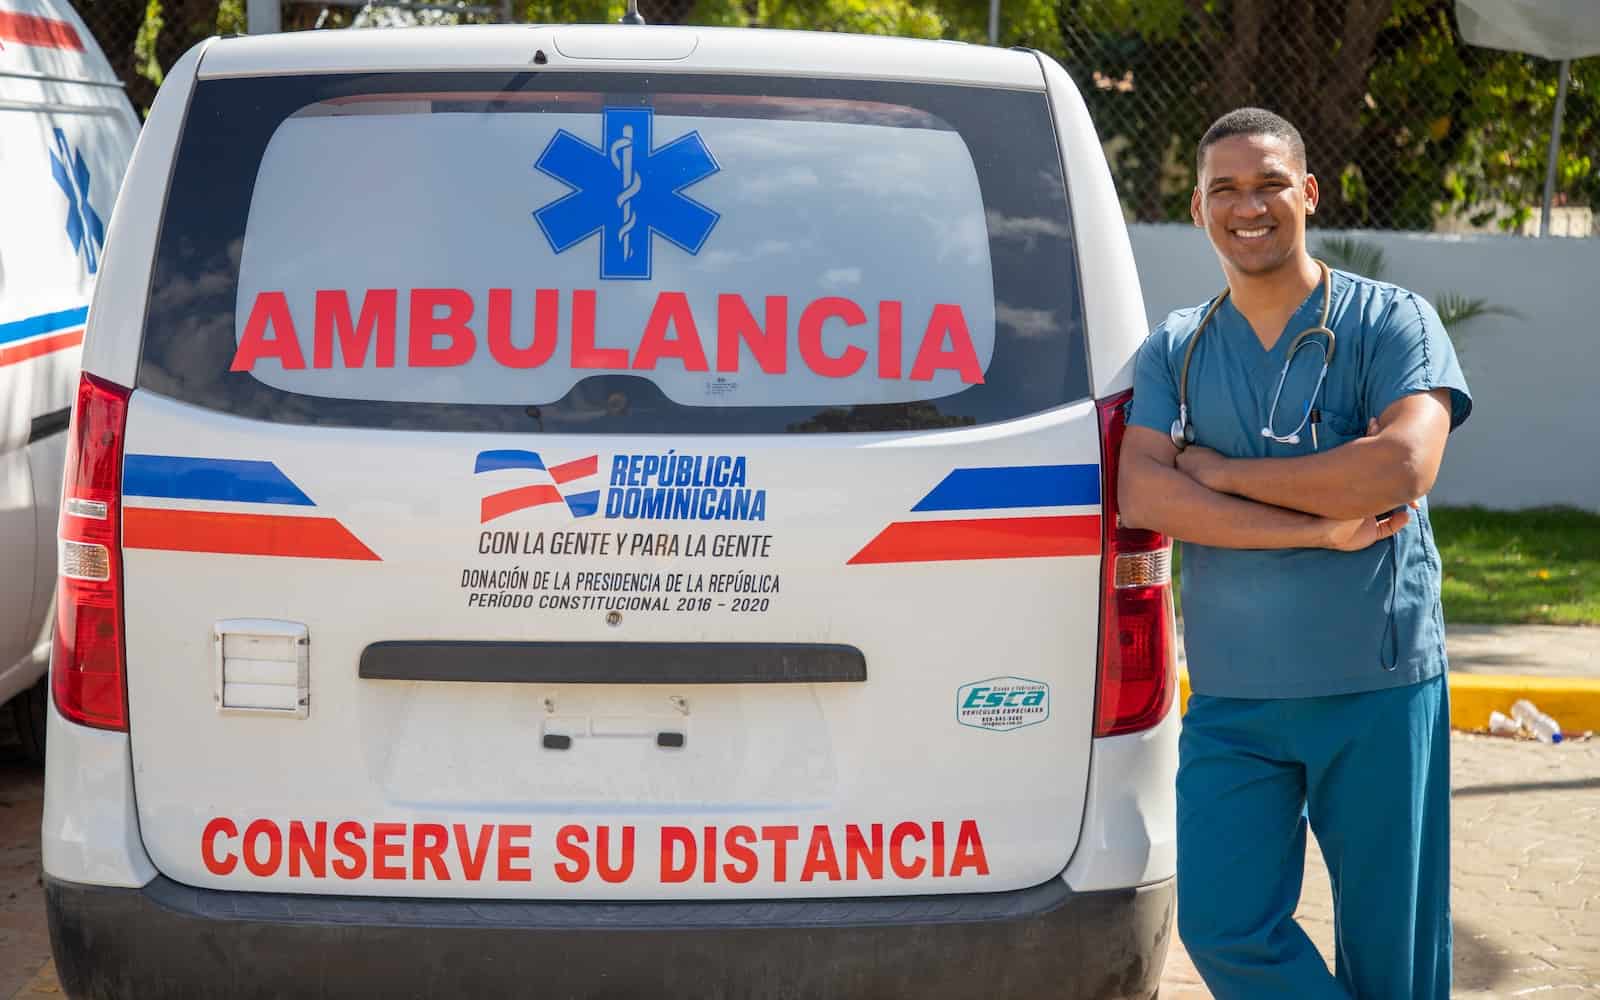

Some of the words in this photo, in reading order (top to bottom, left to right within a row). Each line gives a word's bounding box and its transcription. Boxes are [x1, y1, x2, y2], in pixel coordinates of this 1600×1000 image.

[230, 287, 984, 385] AMBULANCIA
[609, 448, 747, 487] REPÚBLICA
[604, 488, 767, 522] DOMINICANA
[479, 531, 519, 555] CON
[523, 531, 544, 555] LA
[550, 532, 612, 556] GENTE
[616, 532, 628, 556] Y
[630, 533, 679, 557] PARA
[685, 534, 706, 557] LA
[712, 534, 773, 558] GENTE
[461, 566, 529, 590] DONACIÓN
[532, 571, 550, 591] DE
[554, 571, 570, 591] LA
[576, 571, 661, 593] PRESIDENCIA
[665, 573, 684, 593] DE
[687, 573, 703, 593] LA
[708, 569, 780, 593] REPÚBLICA
[468, 591, 534, 609] PERÍODO
[539, 594, 670, 612] CONSTITUCIONAL
[676, 597, 712, 612] 2016
[731, 597, 769, 612] 2020
[962, 687, 1045, 708] Esca
[201, 817, 533, 882] CONSERVE
[554, 824, 636, 884] SU
[659, 819, 989, 884] DISTANCIA
